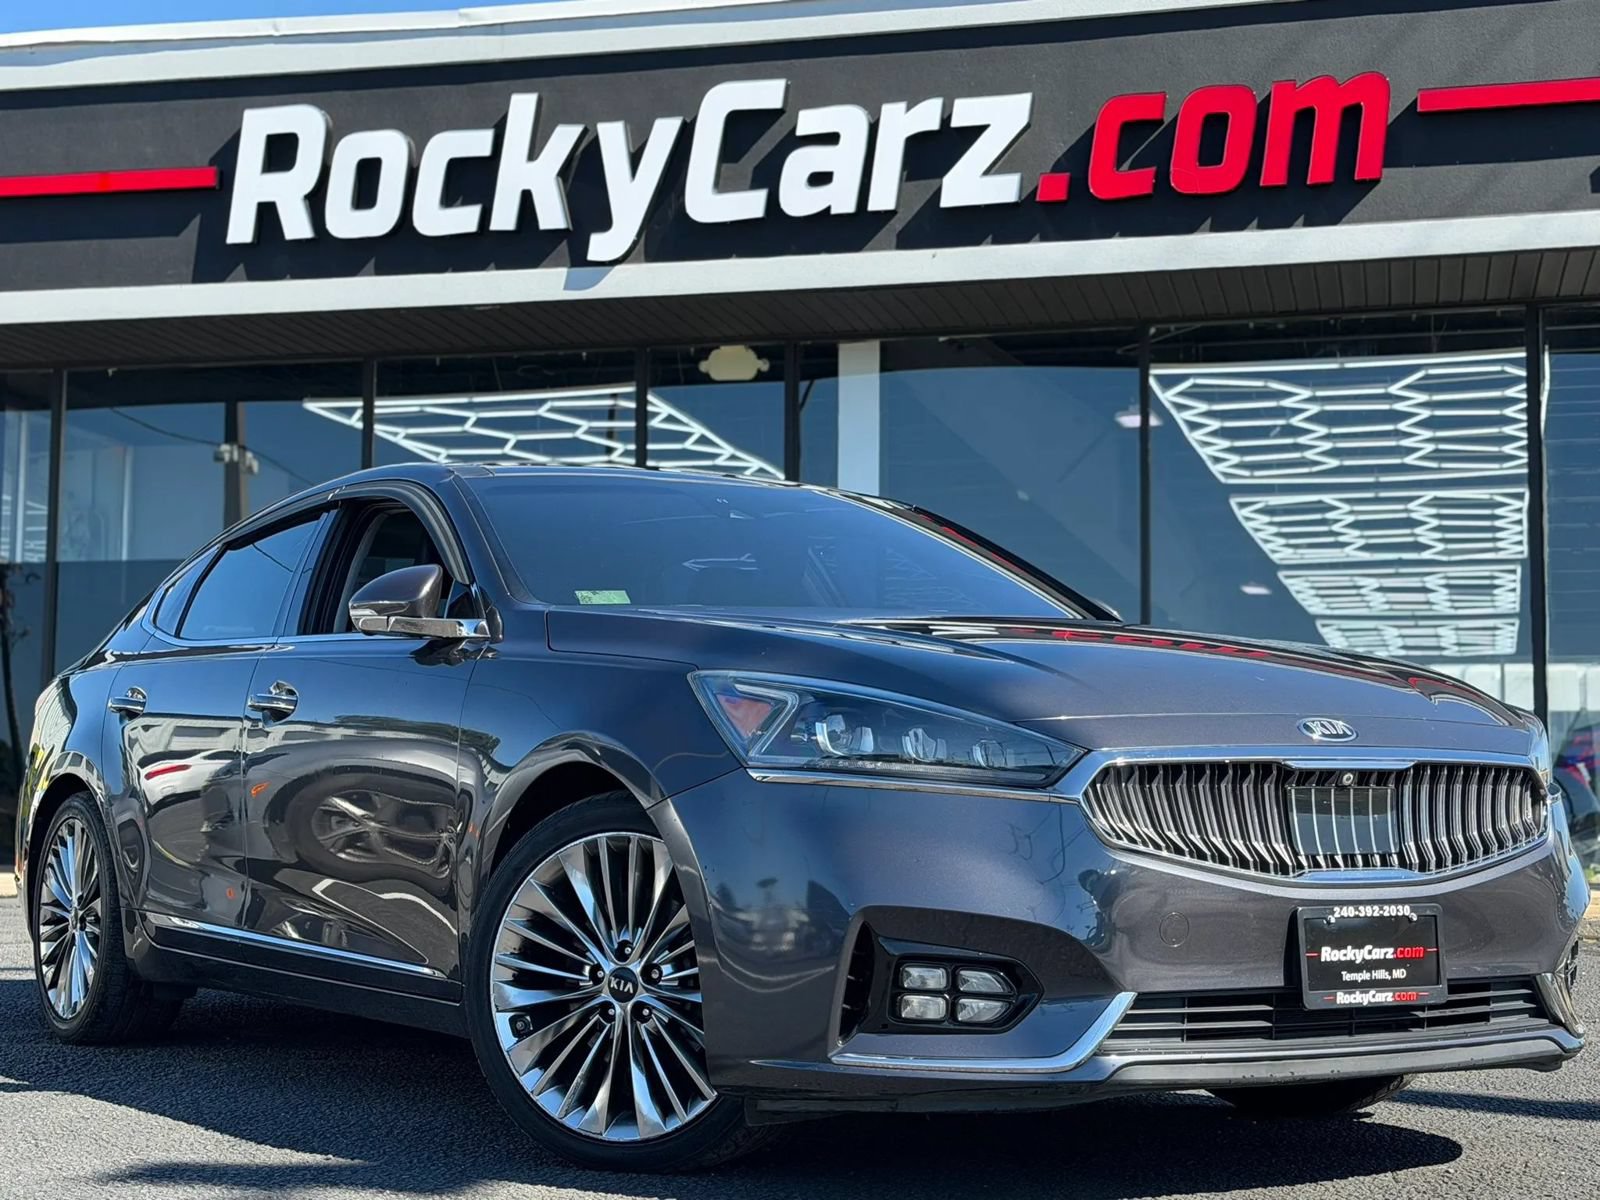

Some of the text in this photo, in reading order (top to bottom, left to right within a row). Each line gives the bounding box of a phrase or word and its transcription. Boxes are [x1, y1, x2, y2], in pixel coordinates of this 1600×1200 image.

[226, 72, 1391, 264] RockyCarz.com
[1306, 720, 1352, 735] KIA
[1333, 905, 1411, 917] 240-392-2030
[1321, 945, 1424, 964] RockyCarz.com
[1341, 969, 1407, 982] Temple Hills, MD
[610, 976, 633, 994] KIA
[1336, 990, 1417, 1005] RockyCarz.com
